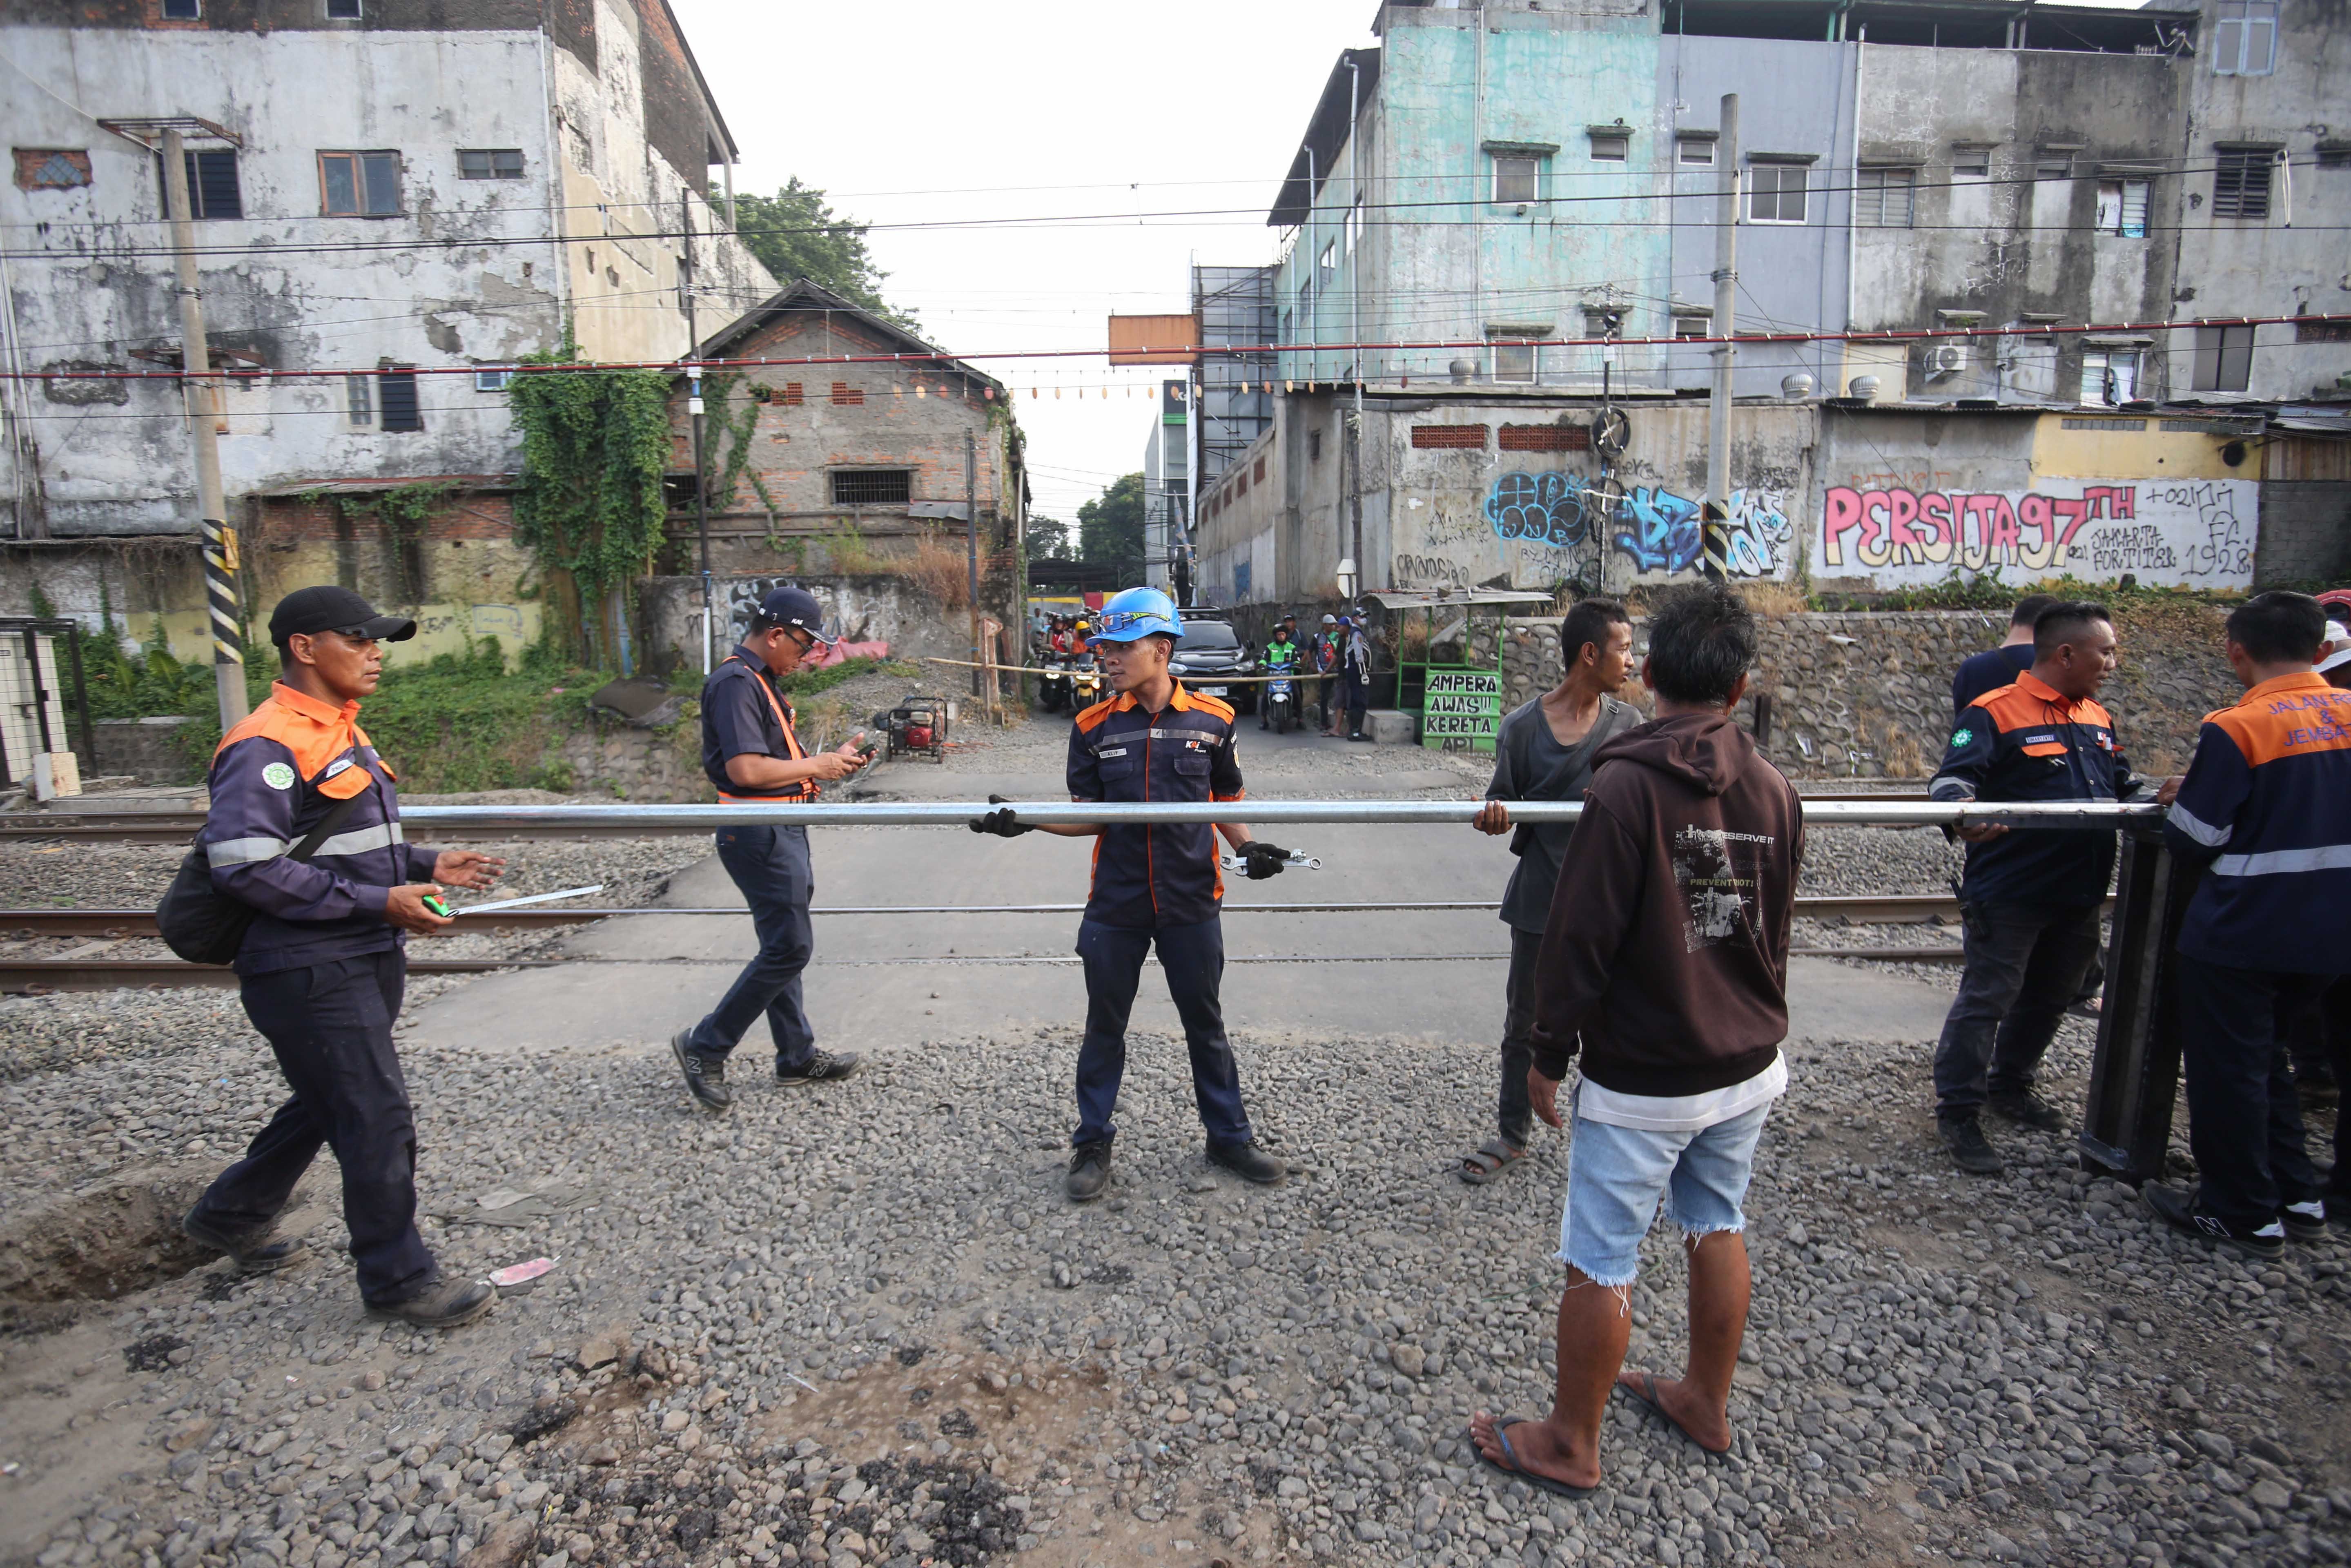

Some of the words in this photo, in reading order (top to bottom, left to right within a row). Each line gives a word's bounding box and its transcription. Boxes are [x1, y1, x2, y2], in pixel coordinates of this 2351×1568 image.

[2090, 525, 2164, 550] JAKARTA
[1426, 675, 1498, 693] AMPERA
[2267, 695, 2329, 715] JALAN
[1425, 716, 1492, 734] KERETA
[2320, 709, 2335, 724] &
[1441, 735, 1474, 754] API
[1690, 878, 1732, 887] PREVENT
